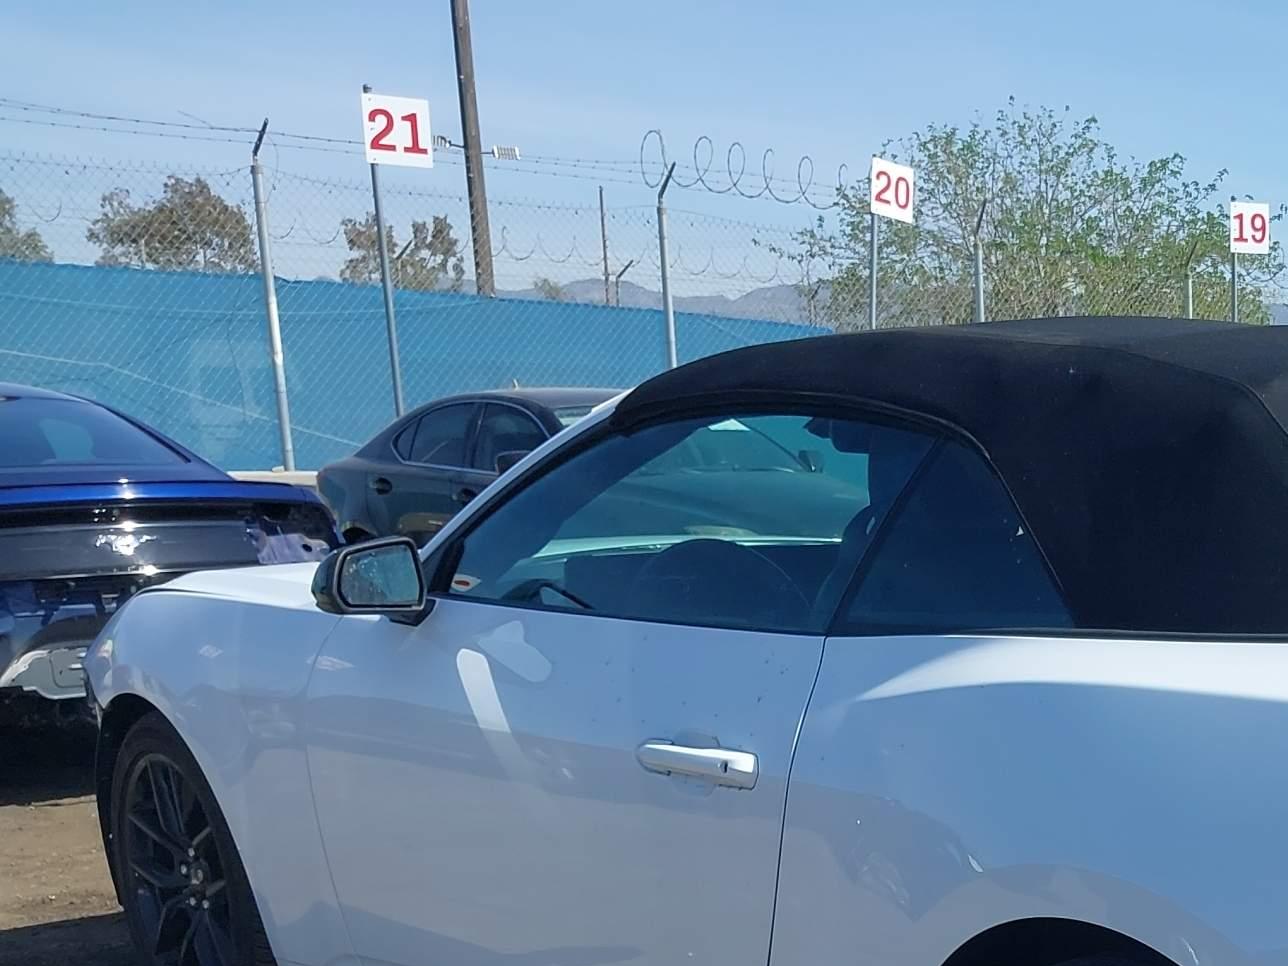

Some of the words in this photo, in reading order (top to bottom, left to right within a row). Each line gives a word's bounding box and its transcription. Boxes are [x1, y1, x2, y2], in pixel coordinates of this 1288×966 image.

[368, 108, 428, 155] 21
[875, 171, 910, 209] 20
[1233, 212, 1266, 243] 19
